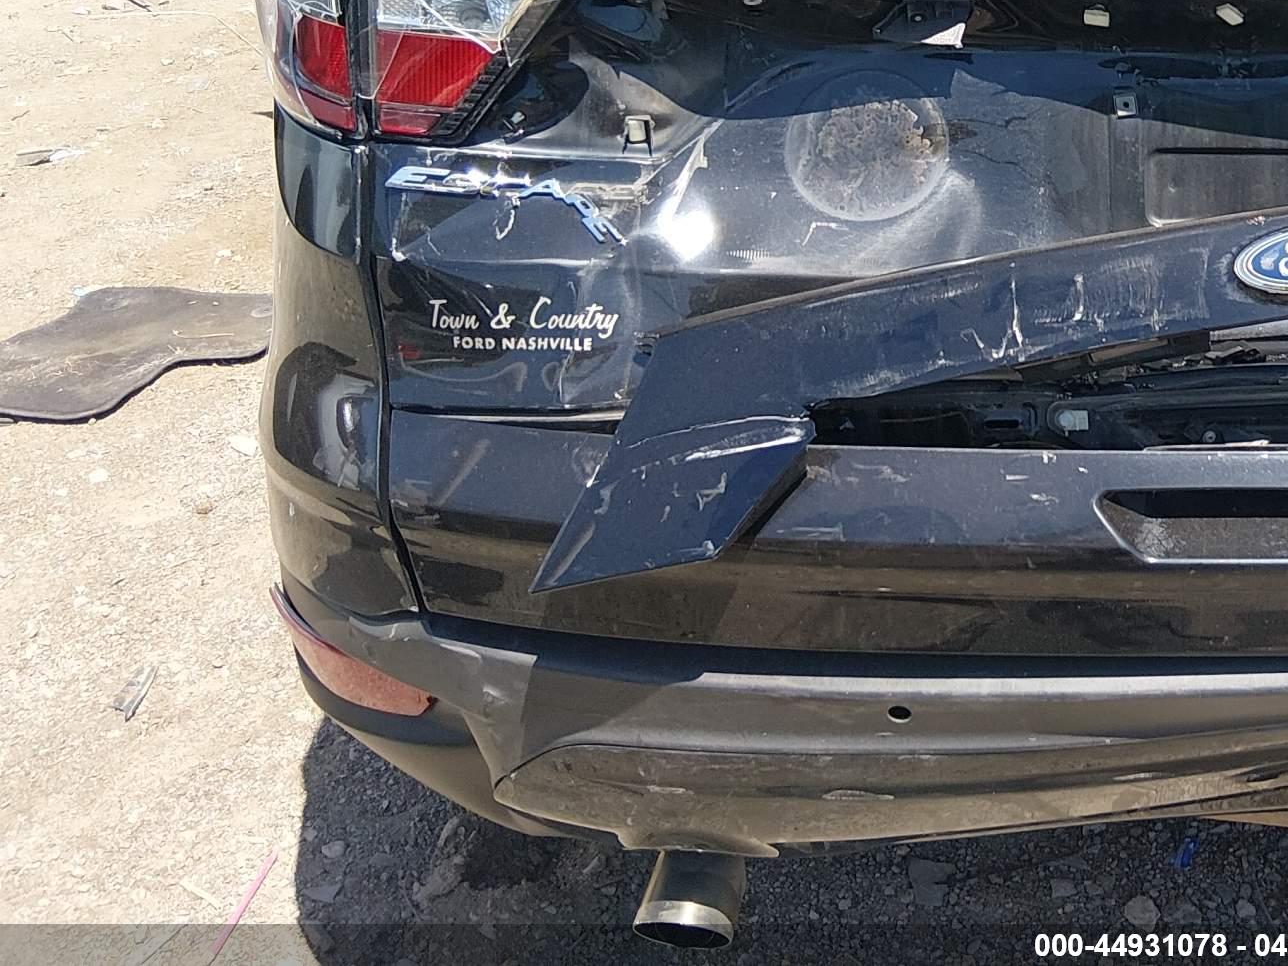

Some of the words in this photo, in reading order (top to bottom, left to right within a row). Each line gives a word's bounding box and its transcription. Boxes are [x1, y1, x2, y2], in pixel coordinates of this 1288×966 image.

[428, 299, 479, 329] Town
[490, 303, 516, 330] &
[529, 296, 619, 339] Country
[453, 336, 496, 350] FORD
[501, 337, 593, 352] NASHVILLE
